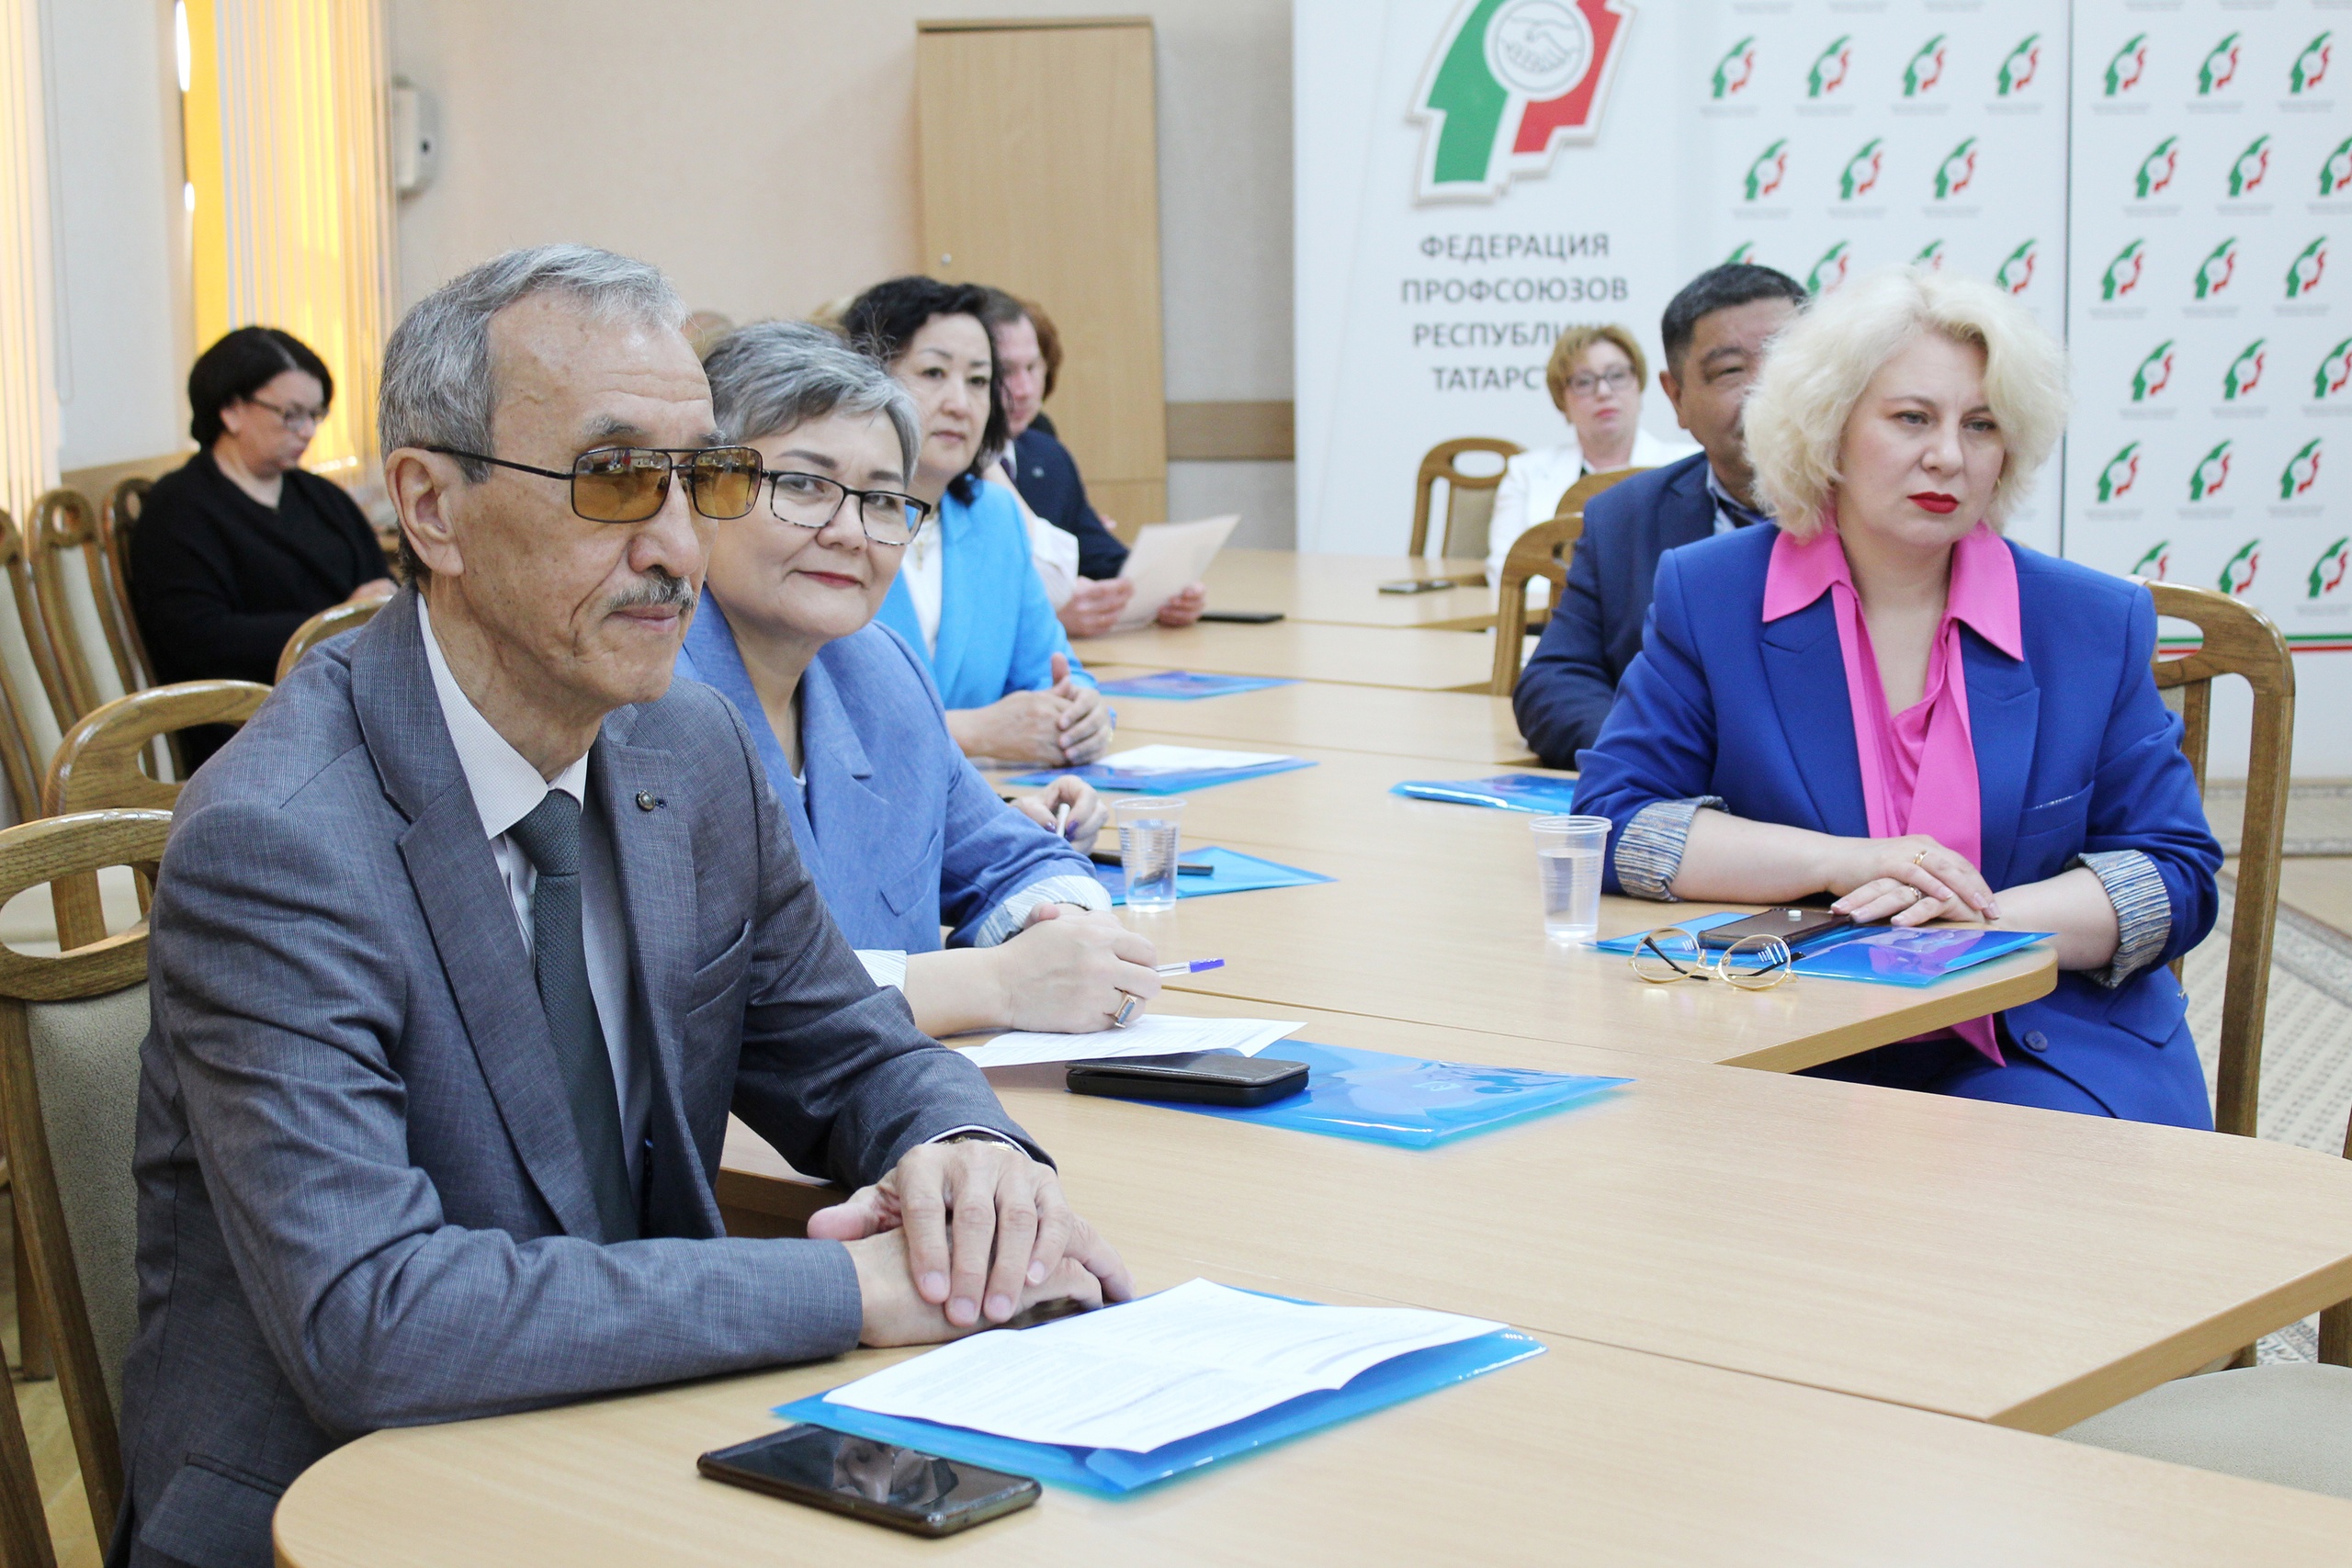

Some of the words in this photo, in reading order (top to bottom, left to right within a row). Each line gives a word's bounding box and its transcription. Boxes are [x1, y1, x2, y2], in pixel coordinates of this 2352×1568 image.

[1419, 233, 1610, 263] ФЕДЕРАЦИЯ
[1401, 276, 1629, 303] ПРОФСОЮЗОВ
[1413, 322, 1594, 346] РЕСПУБЛ
[1431, 366, 1546, 390] ТАТАРС
